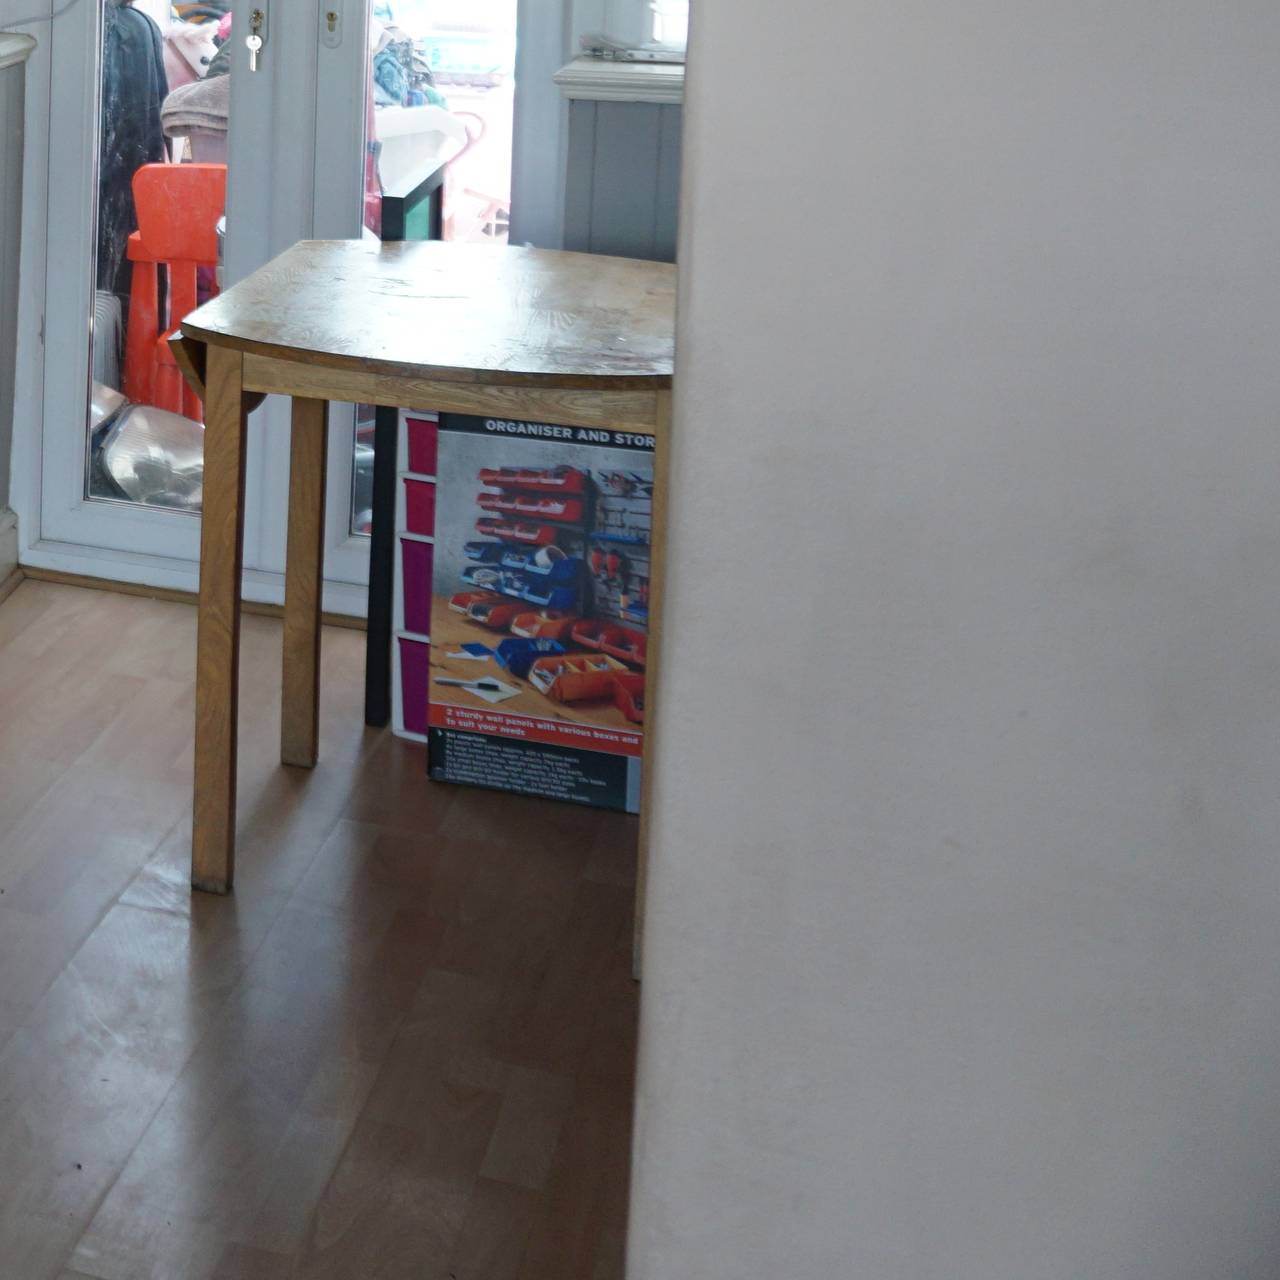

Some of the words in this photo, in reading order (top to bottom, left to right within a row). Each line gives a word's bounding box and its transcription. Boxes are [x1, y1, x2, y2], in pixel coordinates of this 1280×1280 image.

[485, 420, 573, 439] ORGANISER
[577, 430, 610, 443] AND
[615, 434, 656, 448] STOR
[456, 709, 484, 722] sturdy
[487, 713, 504, 723] wall
[507, 717, 534, 729] panels
[538, 721, 556, 732] with
[559, 726, 591, 738] various
[458, 719, 475, 730] suit
[477, 723, 498, 734] your
